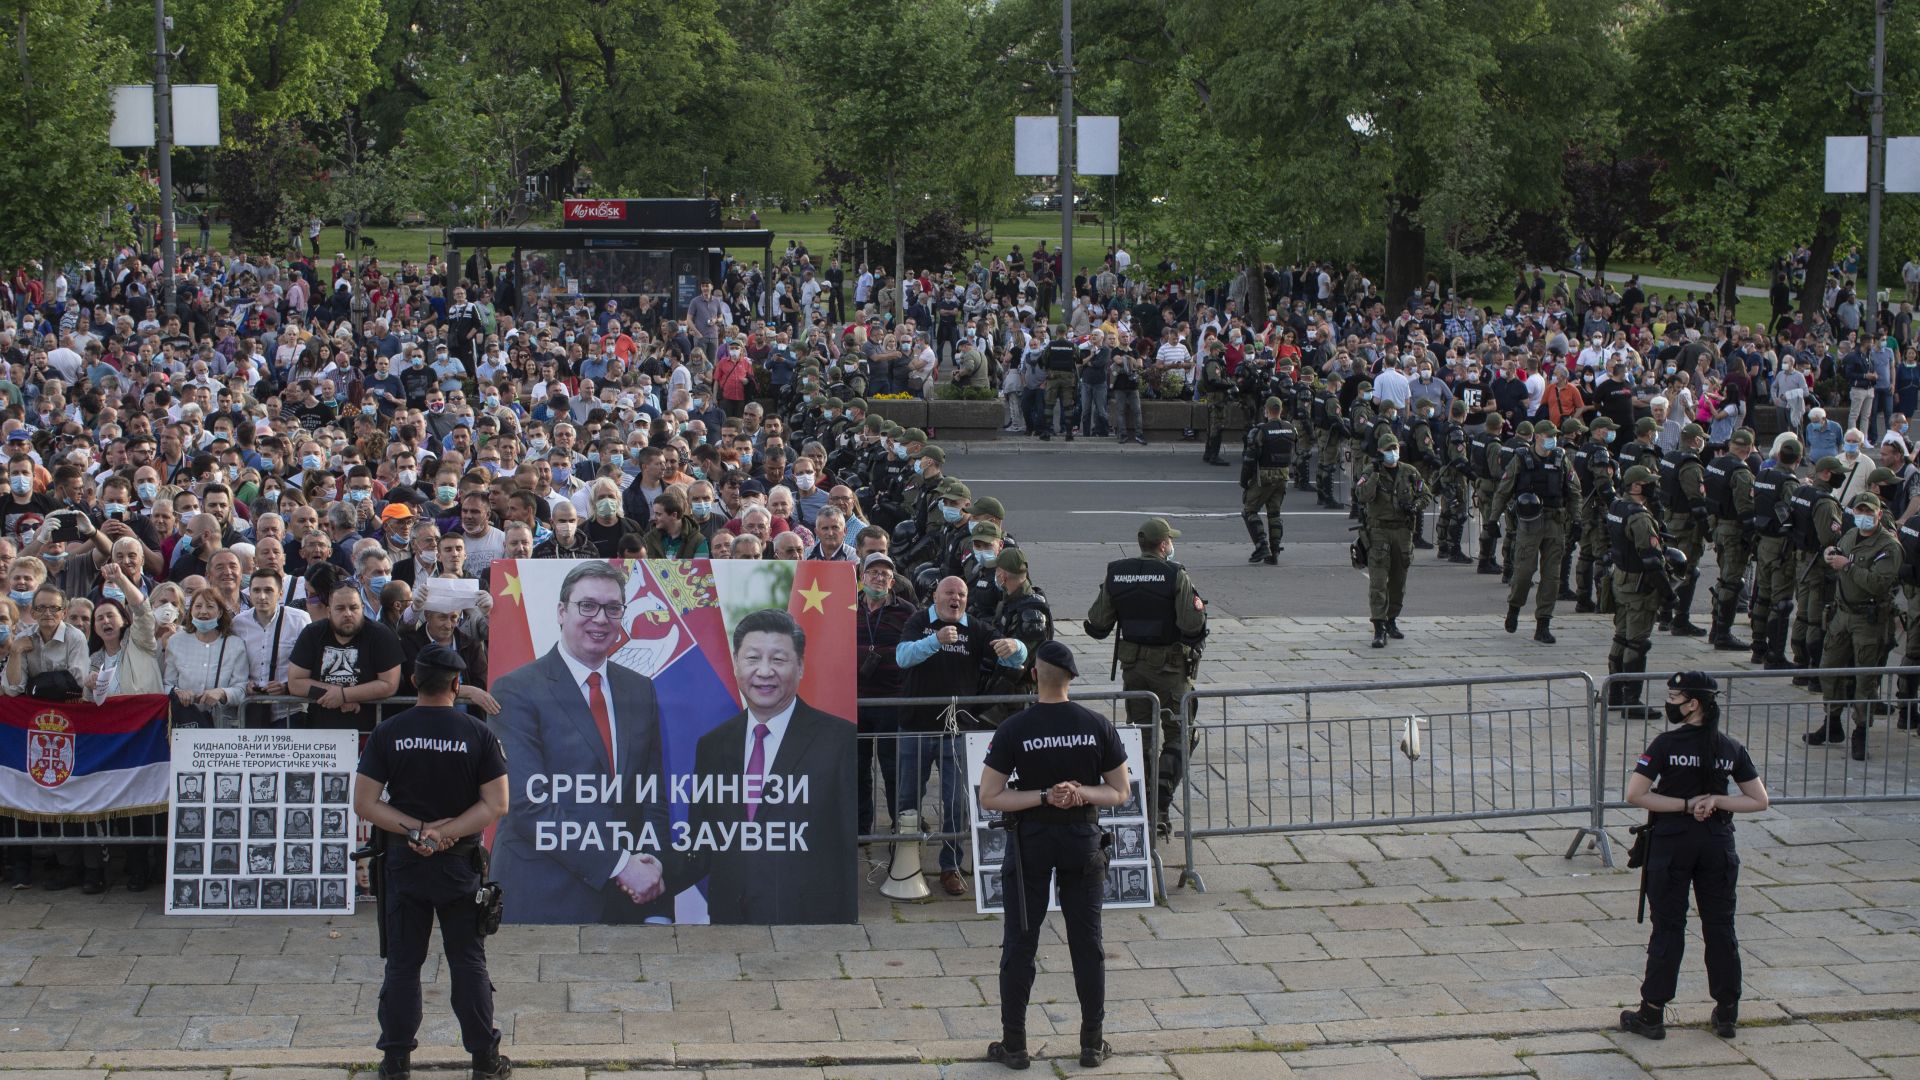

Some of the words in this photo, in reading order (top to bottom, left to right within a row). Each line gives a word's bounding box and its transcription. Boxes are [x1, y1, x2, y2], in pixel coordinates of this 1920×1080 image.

[1113, 574, 1166, 584] ЖАНДАРМЕРИЈА
[324, 675, 359, 683] Reebok
[237, 735, 250, 743] 18.
[253, 735, 269, 743] ЈУЛ
[271, 735, 293, 743] 1998.
[1023, 734, 1097, 752] ПОЛИЦИЈА
[193, 743, 263, 752] КИДНАПОВАНИ
[264, 743, 271, 751] И
[272, 743, 312, 751] УБИЈЕНИ
[313, 743, 337, 751] СРБИ
[395, 737, 468, 754] ПОЛИЦИЈА
[193, 751, 238, 760] Оптеруша
[245, 751, 286, 760] Ретимље
[292, 751, 337, 761] Ораховац
[192, 760, 206, 769] ОД
[207, 760, 241, 768] СТРАНЕ
[242, 760, 309, 769] ТЕРОРИСТИЧКЕ
[311, 760, 337, 769] УЧК-а
[526, 773, 622, 805] СРБИ
[636, 774, 657, 804] И
[671, 773, 809, 805] КИНЕЗИ
[536, 821, 661, 852] БРАЂА
[671, 821, 809, 852] ЗАУВЕК
